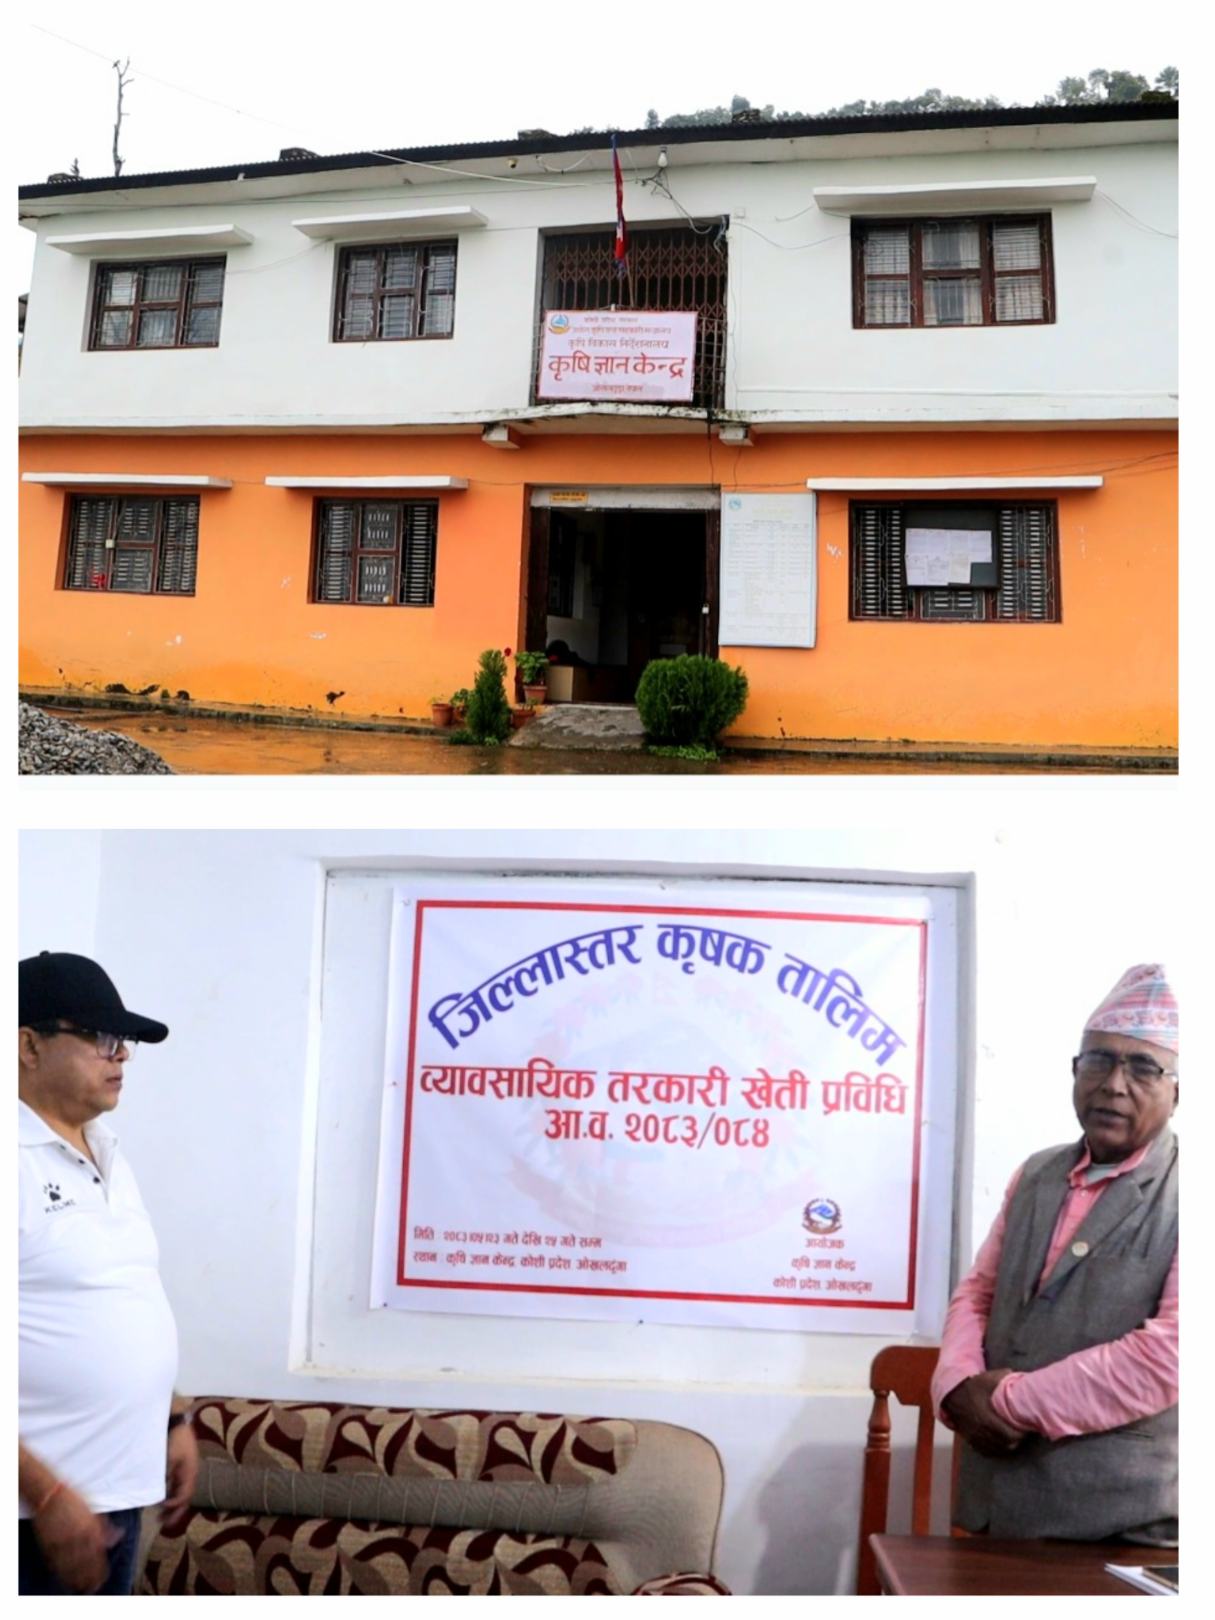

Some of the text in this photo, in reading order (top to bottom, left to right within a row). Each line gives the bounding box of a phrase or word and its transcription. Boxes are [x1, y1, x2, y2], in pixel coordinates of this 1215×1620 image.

[549, 350, 688, 381] कृषि ज्ञान केन्द्र
[428, 923, 907, 1066] जिल्लास्तर कृषक तालिम
[420, 1057, 908, 1116] व्यावसायिक तरकारी खेती प्रविधि
[545, 1109, 769, 1148] आ.व. २०८३/०८४
